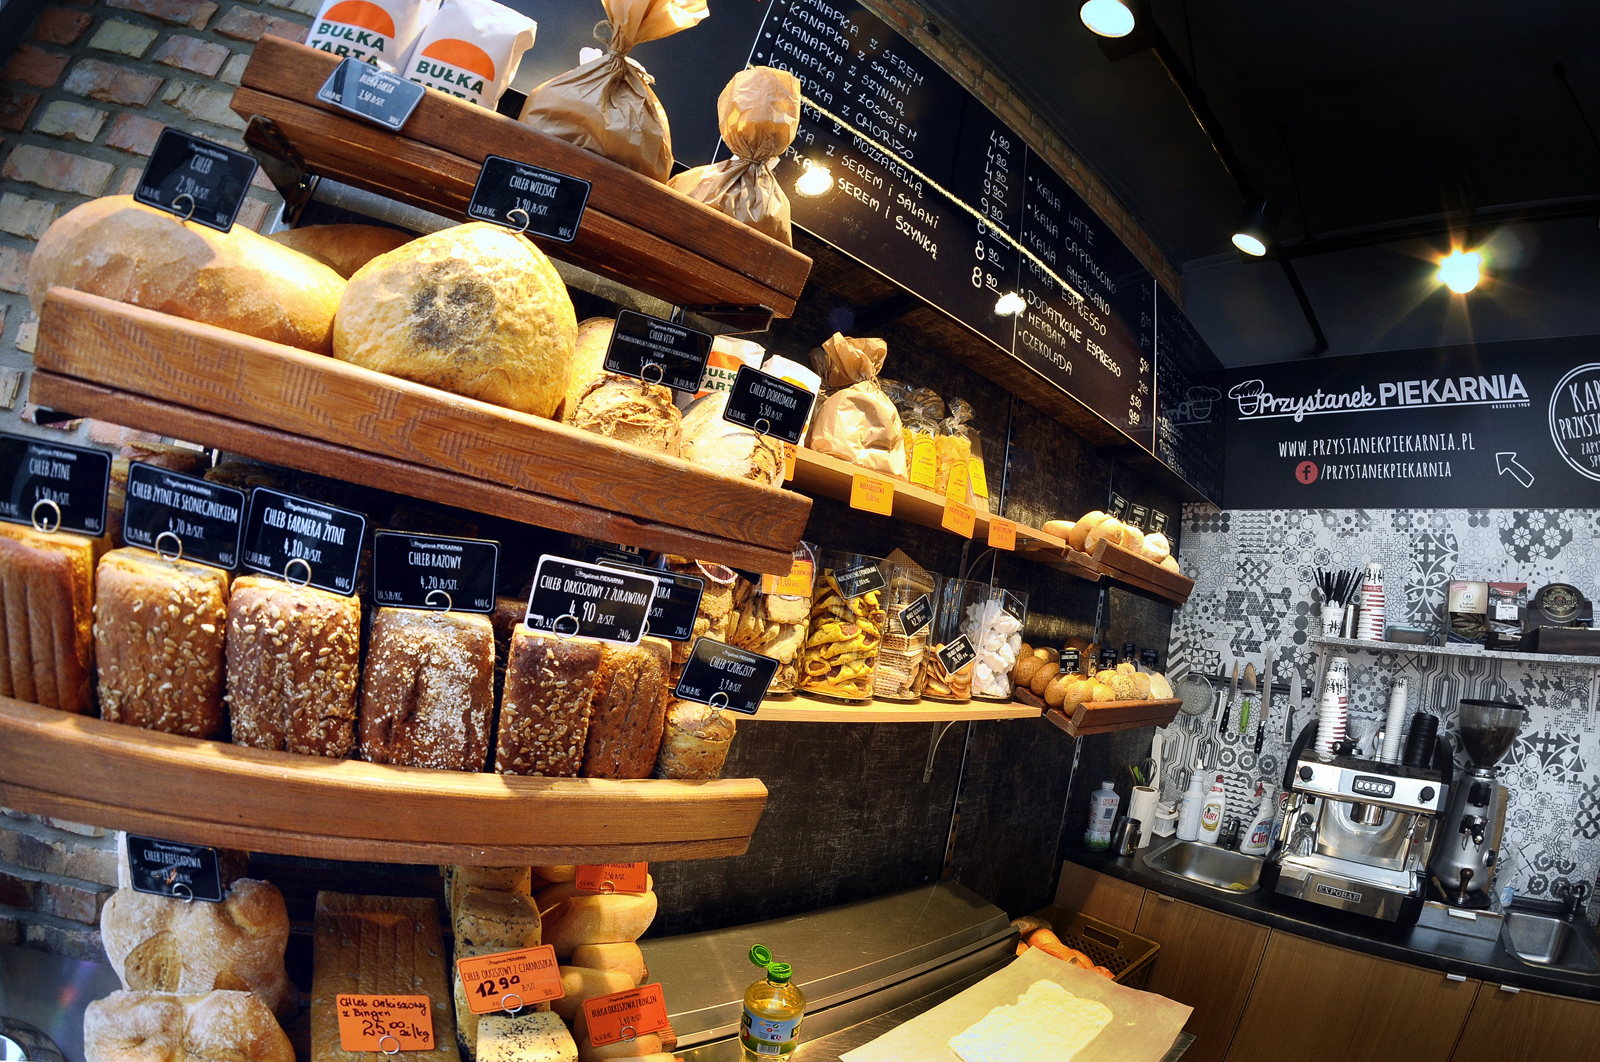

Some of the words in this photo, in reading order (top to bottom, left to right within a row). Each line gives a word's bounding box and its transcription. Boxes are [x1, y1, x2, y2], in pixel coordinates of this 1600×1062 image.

[317, 22, 385, 52] BUŁKA
[789, 2, 850, 50] KANAPKA
[857, 49, 866, 62] Z
[803, 0, 859, 37] ANAPKA
[870, 38, 880, 50] Z
[883, 49, 924, 87] SEREM
[782, 17, 843, 66] KANAPKA
[849, 65, 857, 77] Z
[775, 33, 835, 82] KANAPKA
[843, 81, 853, 94] Z
[415, 60, 484, 96] BUŁKA
[841, 104, 850, 117] Z
[832, 122, 841, 136] Z
[190, 154, 213, 175] CHLEB
[826, 144, 835, 157] Z
[842, 154, 883, 190] SEREM
[509, 175, 530, 191] CHLEB
[530, 180, 558, 199] WIEJSKI
[838, 178, 879, 212] SEREM
[1034, 204, 1059, 239] KAWA
[1037, 178, 1061, 212] KAWA
[1068, 210, 1094, 247] LATTE
[1030, 230, 1057, 266] KAWA
[1029, 258, 1054, 290] KAWA
[1061, 287, 1107, 336] ESPRESSO
[649, 329, 663, 342] CHLEB
[662, 332, 675, 345] VITA
[1027, 289, 1082, 344] DODATKOWE
[1086, 341, 1122, 378] ESPRESSO
[1028, 314, 1067, 349] HERBATA
[1022, 330, 1073, 376] CZEKOLADA
[702, 367, 737, 381] UŁK
[749, 381, 766, 398] CHLEB
[766, 388, 798, 410] DOBROMIRA
[1258, 384, 1378, 422] Przystanek
[1378, 373, 1529, 407] PIEKARNIA
[1278, 432, 1475, 458] WWW.PRZYSTANEKPIEKARNIA.PL
[29, 457, 50, 477] CHLEB
[50, 459, 71, 481] ŻYTNI
[1320, 460, 1452, 481] /PRZYSTANEKPIEKARNIA
[35, 486, 52, 501] 450
[131, 480, 152, 501] CHLEB
[152, 483, 173, 507] ŻYTNI
[173, 490, 181, 509] ZE
[181, 493, 239, 524] SŁONECZNIKIEM
[168, 517, 186, 535] 4,70
[263, 507, 287, 529] CHLEB
[287, 513, 322, 539] FARMERA
[322, 521, 346, 545] ŻYTNI
[283, 537, 303, 558] 4,80
[408, 551, 431, 567] CHLEB
[431, 554, 462, 569] RAZOWY
[420, 575, 438, 590] 4,20
[540, 574, 561, 591] CHLEB
[563, 579, 602, 599] ORKISZOWY
[604, 589, 611, 600] Z
[709, 655, 726, 670] CHLEB
[1203, 811, 1218, 822] FAIRY
[1251, 831, 1268, 844] Clin
[143, 849, 161, 863] CHLEB
[1318, 885, 1360, 901] EXPOBAR
[463, 971, 480, 982] CHLEB
[481, 967, 513, 980] ORKISZOWY
[513, 964, 518, 974] Z
[352, 1008, 391, 1023] Bingen
[591, 1007, 608, 1018] BUŁKA
[607, 999, 636, 1014] ORKISZOWA
[638, 995, 658, 1008] BINGEN
